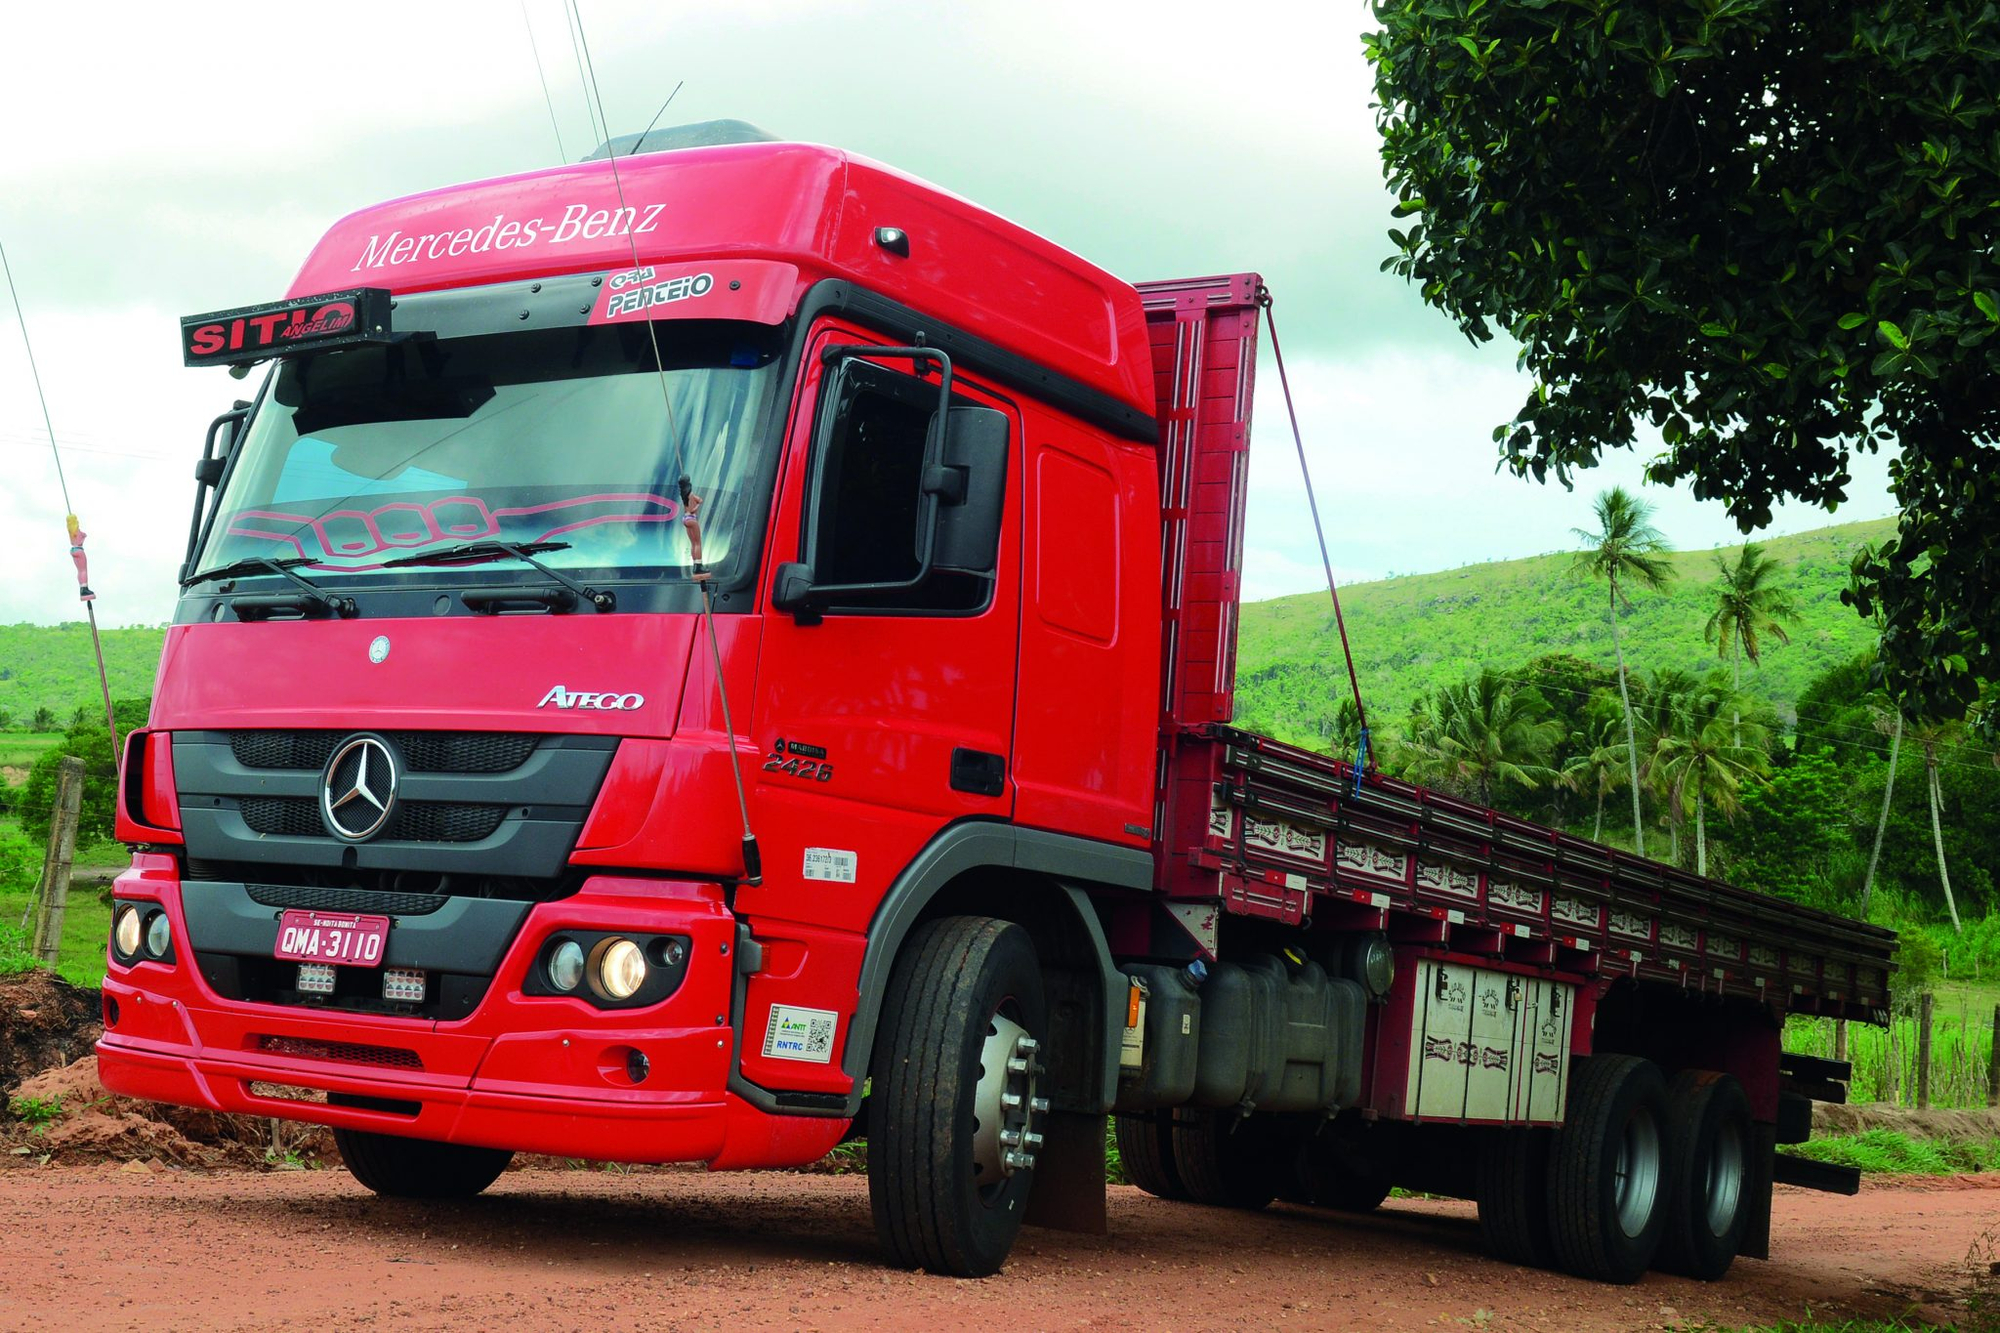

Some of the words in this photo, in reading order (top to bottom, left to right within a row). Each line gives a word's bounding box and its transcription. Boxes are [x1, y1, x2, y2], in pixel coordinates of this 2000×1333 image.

[350, 203, 667, 272] Mercedes-Benz
[281, 314, 351, 338] ANGELIM
[537, 685, 645, 710] ATEGO
[762, 752, 834, 782] 2426
[791, 1023, 807, 1031] ANTT
[776, 1040, 803, 1051] RNTRC
